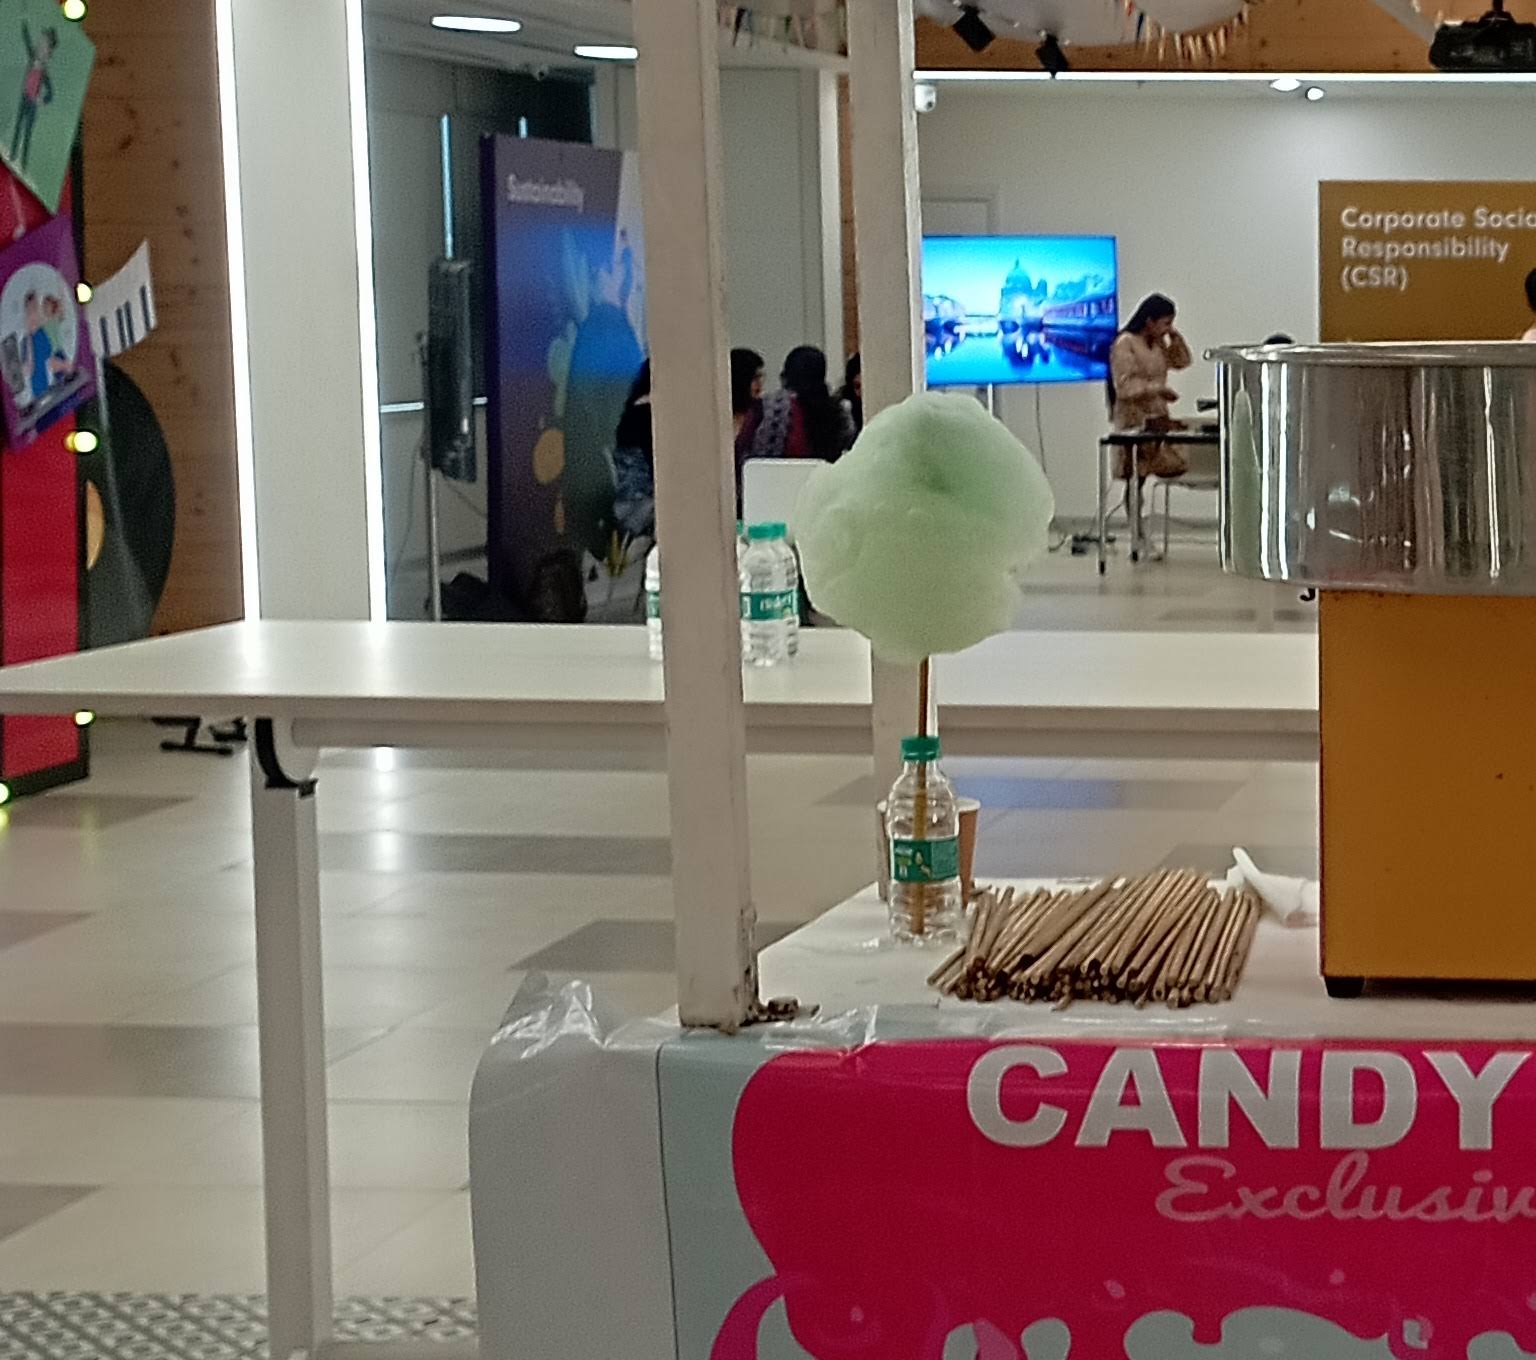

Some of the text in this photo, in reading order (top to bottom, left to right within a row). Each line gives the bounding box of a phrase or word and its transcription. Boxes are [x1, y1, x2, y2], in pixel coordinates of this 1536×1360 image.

[506, 173, 584, 213] Sustainability
[1341, 207, 1466, 234] Corporate
[1341, 237, 1509, 263] Responsibility
[1341, 265, 1408, 292] (CSR)
[965, 1043, 1534, 1150] CANDY
